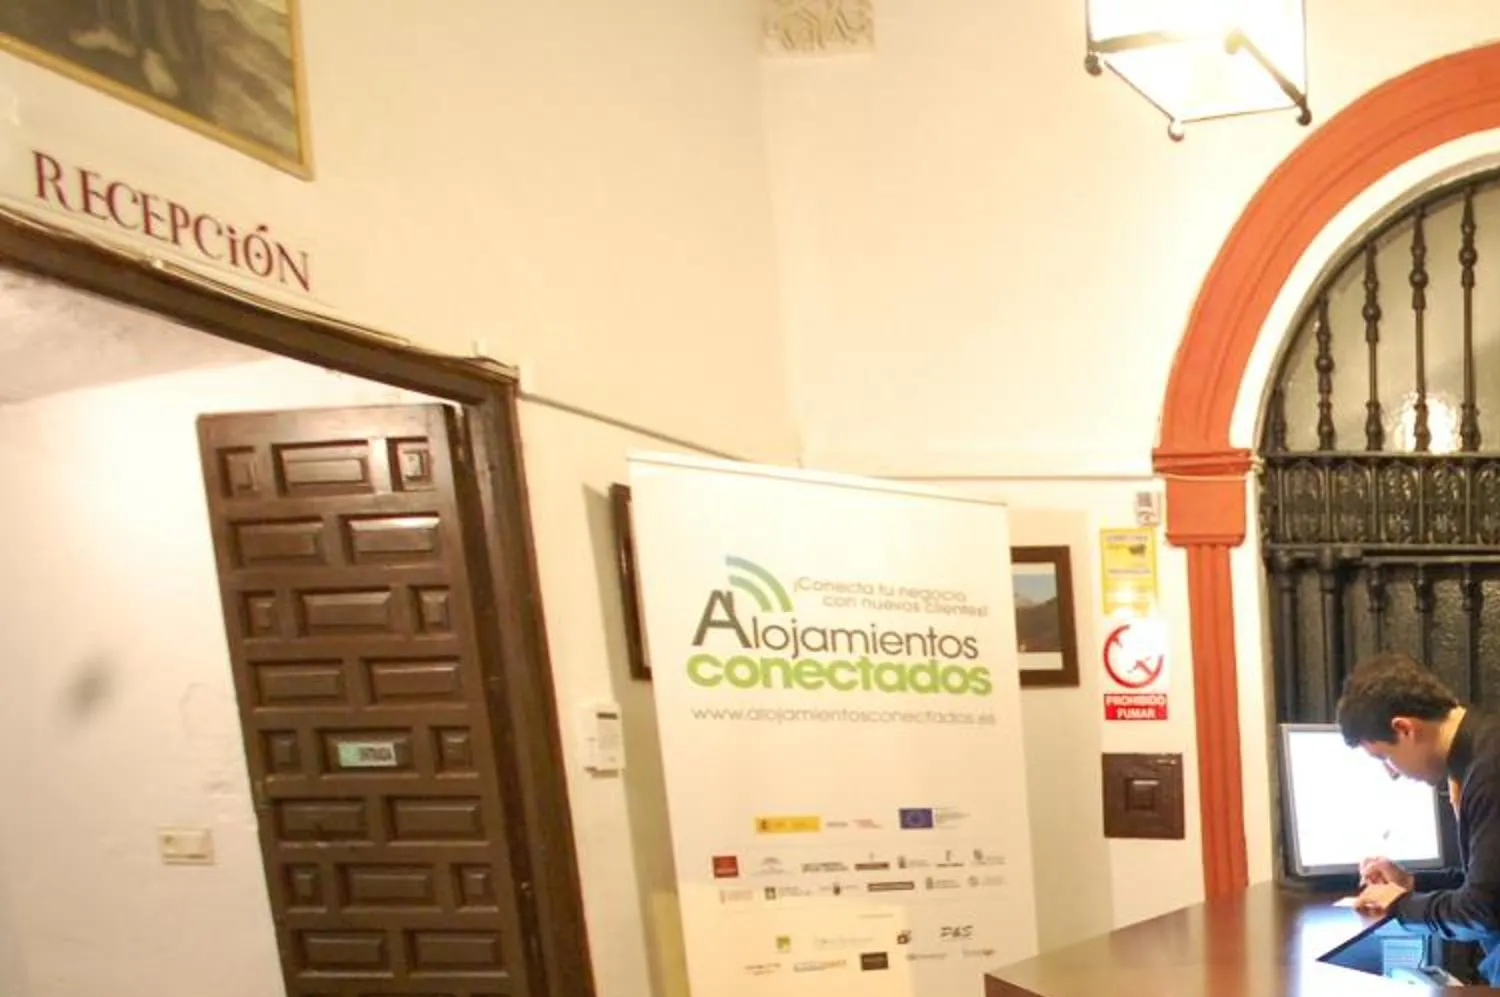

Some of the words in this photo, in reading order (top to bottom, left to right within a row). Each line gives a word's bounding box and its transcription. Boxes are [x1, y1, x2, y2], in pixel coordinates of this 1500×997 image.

[879, 582, 895, 597] tu
[822, 595, 857, 608] con
[692, 589, 979, 659] Alojamientos
[687, 653, 992, 696] conectados
[1117, 706, 1157, 719] FUMAR
